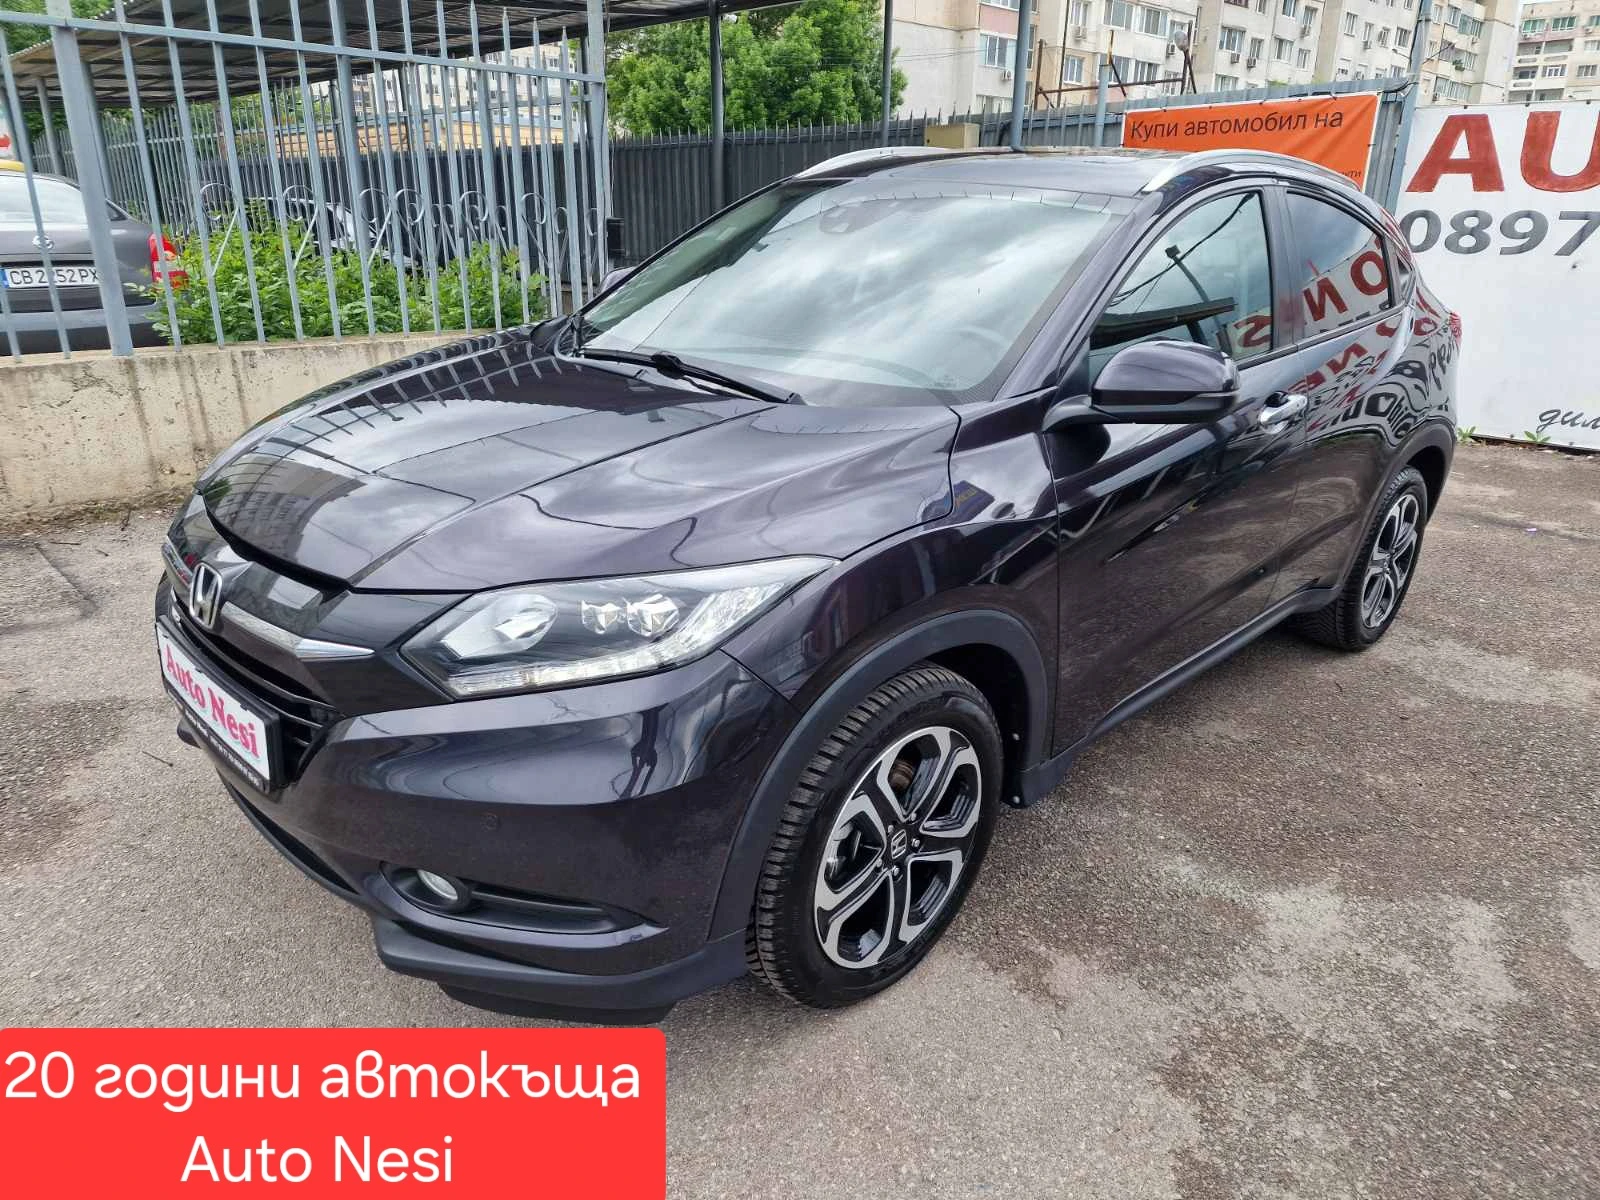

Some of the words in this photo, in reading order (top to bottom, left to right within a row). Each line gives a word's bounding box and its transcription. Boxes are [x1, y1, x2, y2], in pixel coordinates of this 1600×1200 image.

[1130, 120, 1178, 143] Купи
[1183, 111, 1307, 136] автомобил
[1314, 111, 1344, 129] на
[1405, 110, 1600, 193] AU
[1400, 209, 1600, 257] 0897
[35, 269, 78, 284] 252
[165, 643, 206, 710] Auto
[207, 687, 260, 758] Nesi
